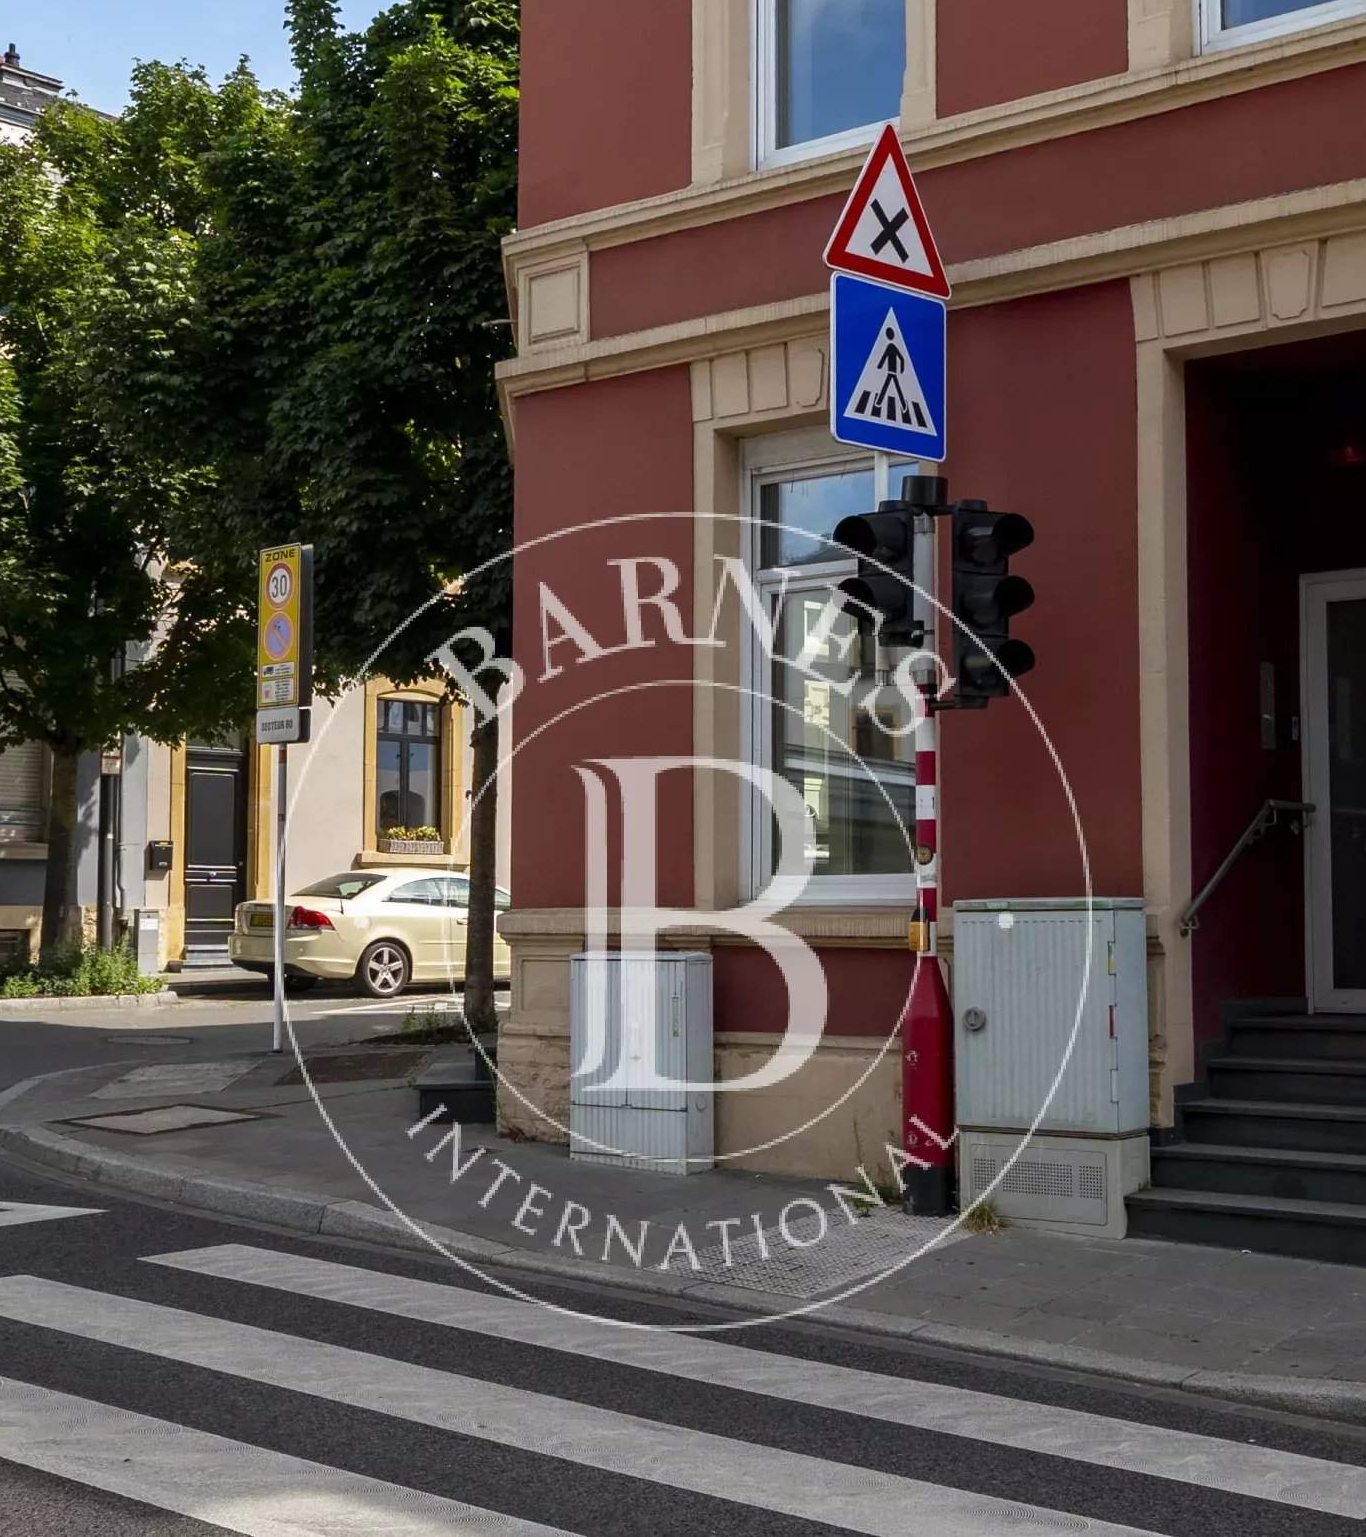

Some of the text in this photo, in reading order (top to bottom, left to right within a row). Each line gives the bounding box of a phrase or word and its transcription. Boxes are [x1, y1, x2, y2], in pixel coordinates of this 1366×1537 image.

[265, 549, 296, 562] ZONE
[271, 574, 288, 598] 30
[261, 720, 285, 732] SECTEUR
